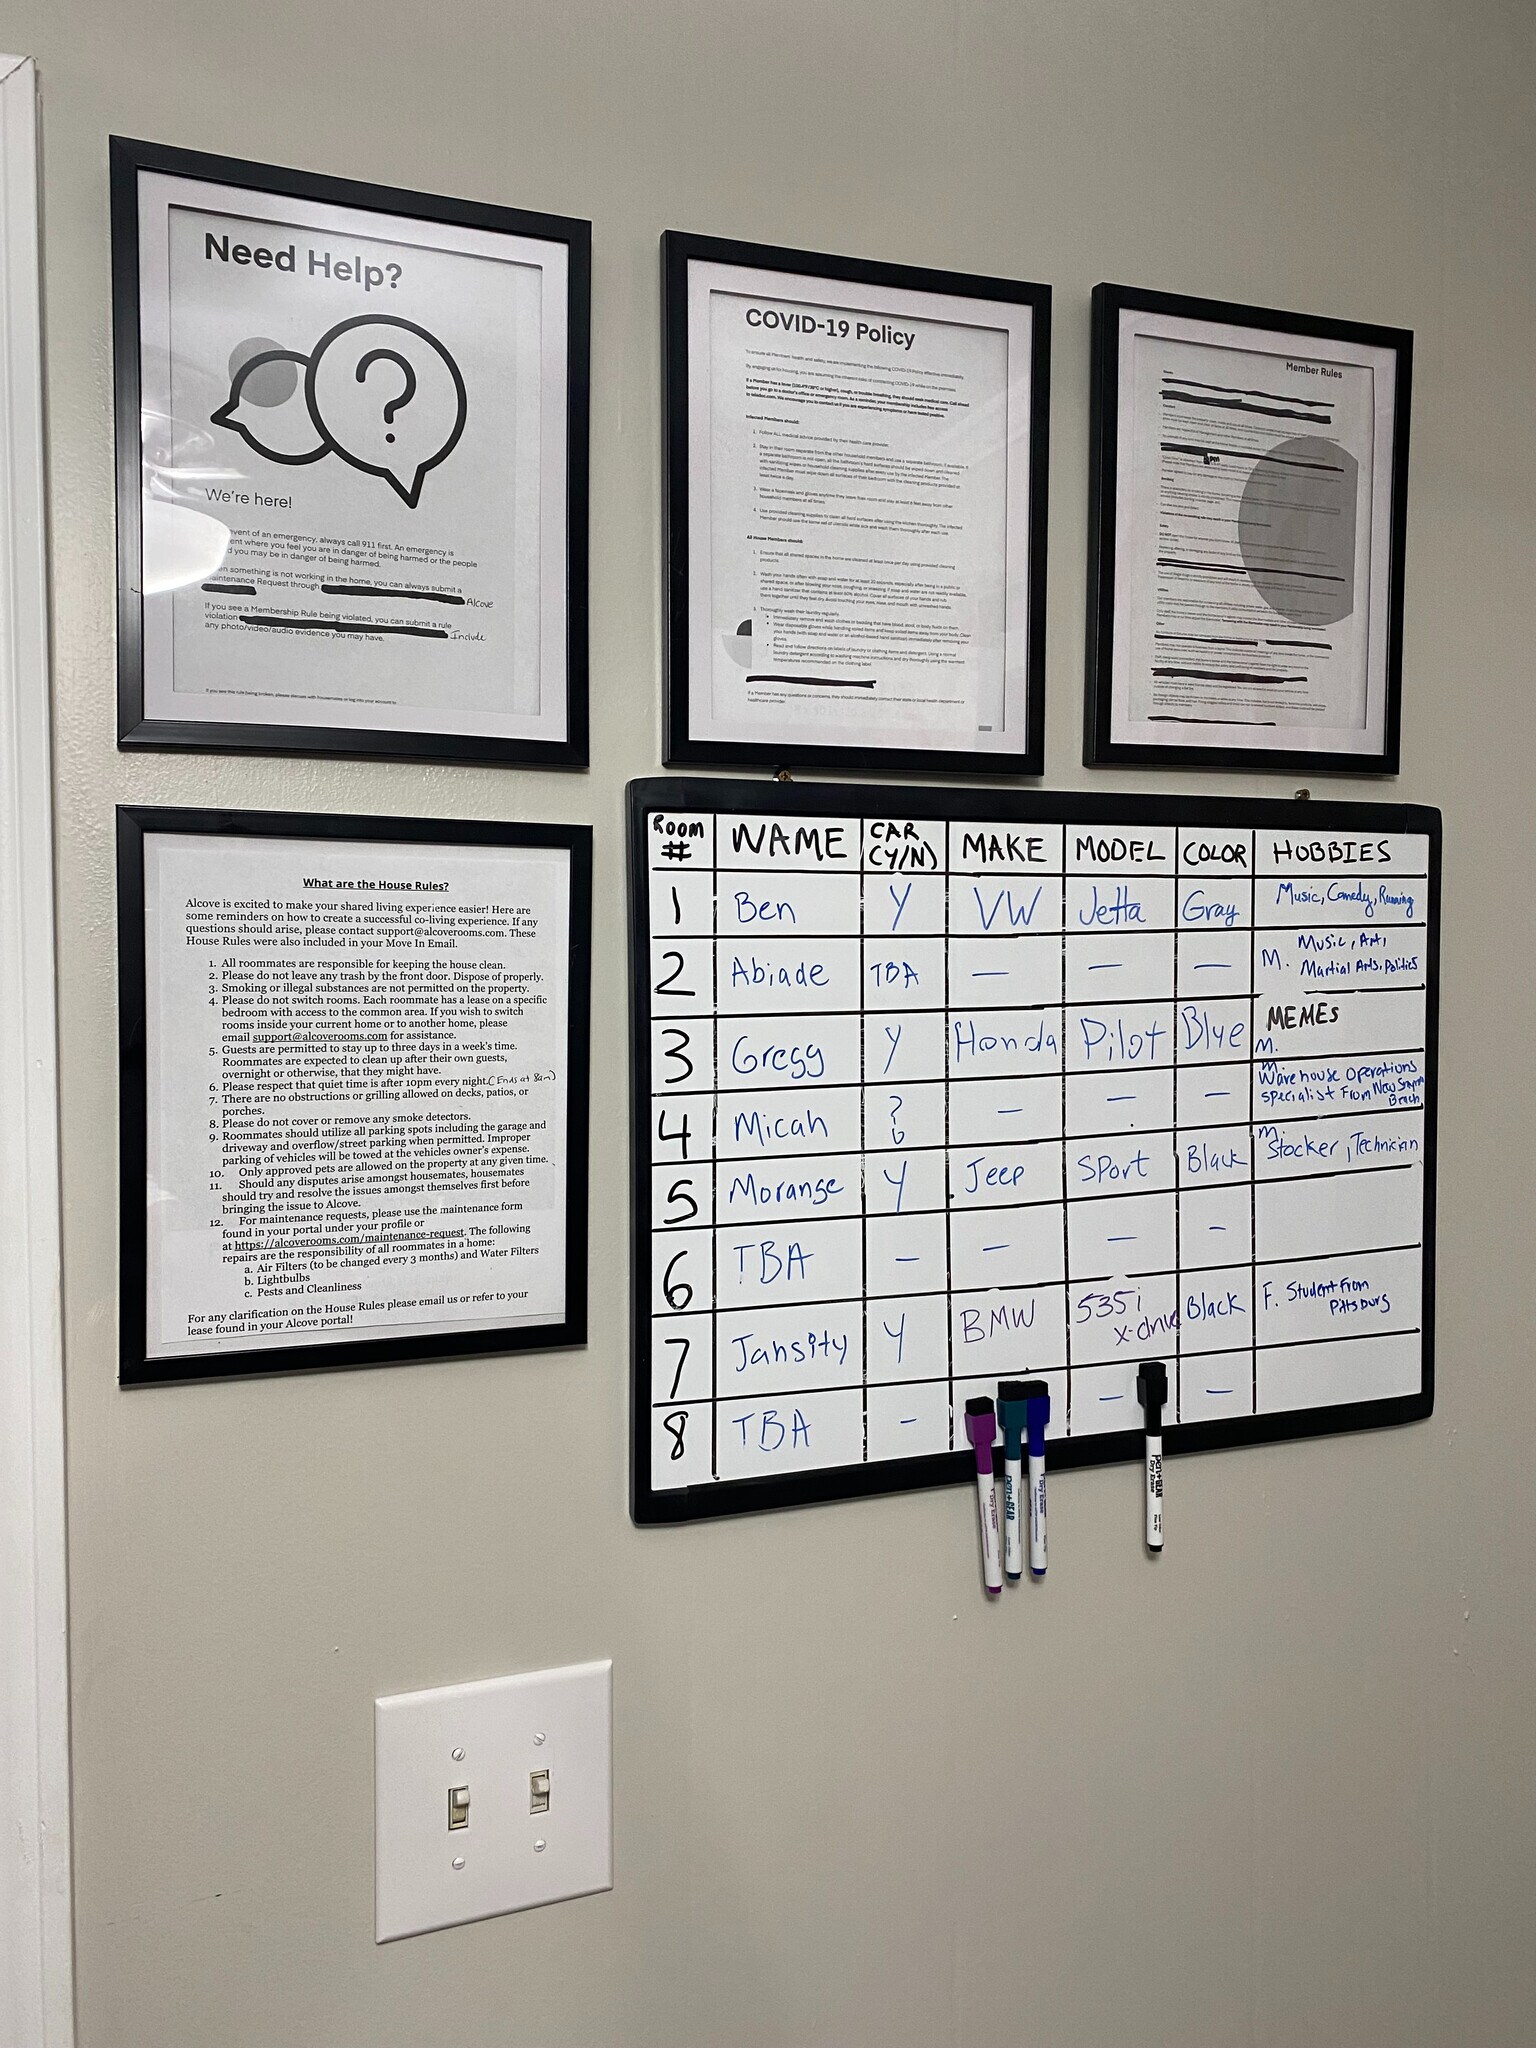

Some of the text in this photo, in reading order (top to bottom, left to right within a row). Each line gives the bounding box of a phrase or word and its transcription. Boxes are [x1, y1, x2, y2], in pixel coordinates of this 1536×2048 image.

[205, 232, 403, 291] Need Help?
[745, 308, 916, 351] COVID-19 Policy
[1286, 362, 1343, 379] Member Rules
[206, 487, 293, 510] We're here!
[251, 528, 261, 538] of
[272, 533, 319, 545] emergency,
[319, 535, 347, 548] always
[346, 538, 362, 547] call
[361, 539, 376, 549] 911
[377, 541, 394, 550] first.
[394, 542, 406, 552] An
[405, 546, 448, 558] emergency
[448, 548, 455, 557] is
[256, 577, 320, 591] Request through
[466, 597, 494, 608] Alcove
[205, 620, 220, 629] any
[295, 626, 331, 636] evidence
[331, 631, 346, 640] you
[347, 632, 364, 641] may
[365, 631, 384, 641] have.
[653, 814, 704, 838] Room
[870, 822, 920, 842] CAR
[732, 823, 847, 861] NAME
[869, 841, 937, 870] (Y/N)
[963, 833, 1047, 863] MAKE
[1076, 837, 1166, 862] MODEL
[1183, 842, 1247, 868] COLOR
[1273, 839, 1391, 864] HOBBIES
[303, 878, 449, 891] What are the House Rules?
[1276, 882, 1324, 904] Music,
[185, 897, 532, 916] Alcove is excited to make your shared living experience easier! Here are
[734, 892, 795, 923] Ben
[973, 886, 1042, 930] VW
[1080, 886, 1146, 925] Jetta
[1182, 890, 1240, 926] Gray
[186, 922, 236, 936] questions
[238, 923, 274, 934] should
[274, 923, 303, 937] arise,
[305, 924, 337, 938] please
[338, 924, 375, 935] contact
[508, 927, 537, 938] These
[654, 951, 696, 996] 2
[870, 962, 919, 989] TBA
[1300, 959, 1350, 978] Martial
[222, 1032, 251, 1043] email
[390, 1030, 405, 1041] for
[406, 1029, 458, 1040] assistance.
[955, 1020, 1057, 1063] Honda
[1080, 1018, 1166, 1061] Pilot
[662, 1029, 693, 1084] 3
[732, 1036, 824, 1079] Gregg
[658, 1110, 691, 1159] 4
[1188, 1145, 1248, 1173] Black
[663, 1179, 698, 1224] 5
[222, 1242, 234, 1253] at
[468, 1225, 488, 1236] The
[488, 1222, 532, 1238] following
[733, 1241, 814, 1284] TBA
[663, 1250, 694, 1312] 6
[960, 1299, 1034, 1343] BMW
[1187, 1292, 1245, 1320] Black
[187, 1313, 354, 1336] lease found in your Alcove portal!
[664, 1338, 692, 1401] 7
[663, 1411, 689, 1460] 8
[732, 1409, 811, 1451] TBA
